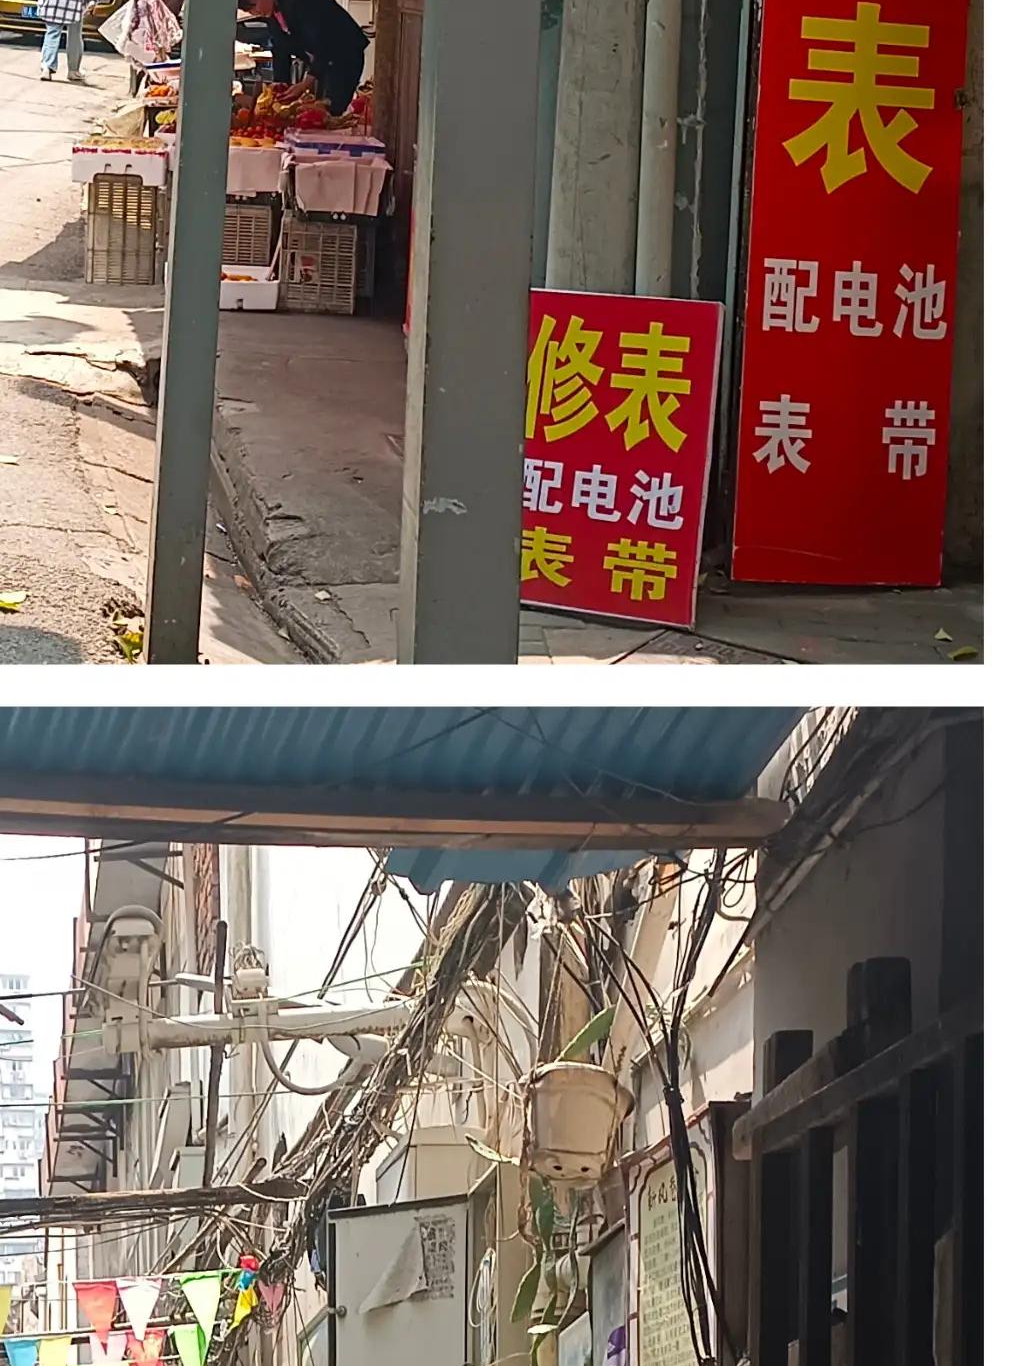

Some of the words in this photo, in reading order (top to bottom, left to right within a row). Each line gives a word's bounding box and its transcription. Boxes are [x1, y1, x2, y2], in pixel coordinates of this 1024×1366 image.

[762, 257, 947, 340] 配电池
[525, 314, 691, 453] 修表
[753, 394, 936, 481] 表带
[523, 458, 683, 530] 配电池
[520, 526, 677, 601] 表带
